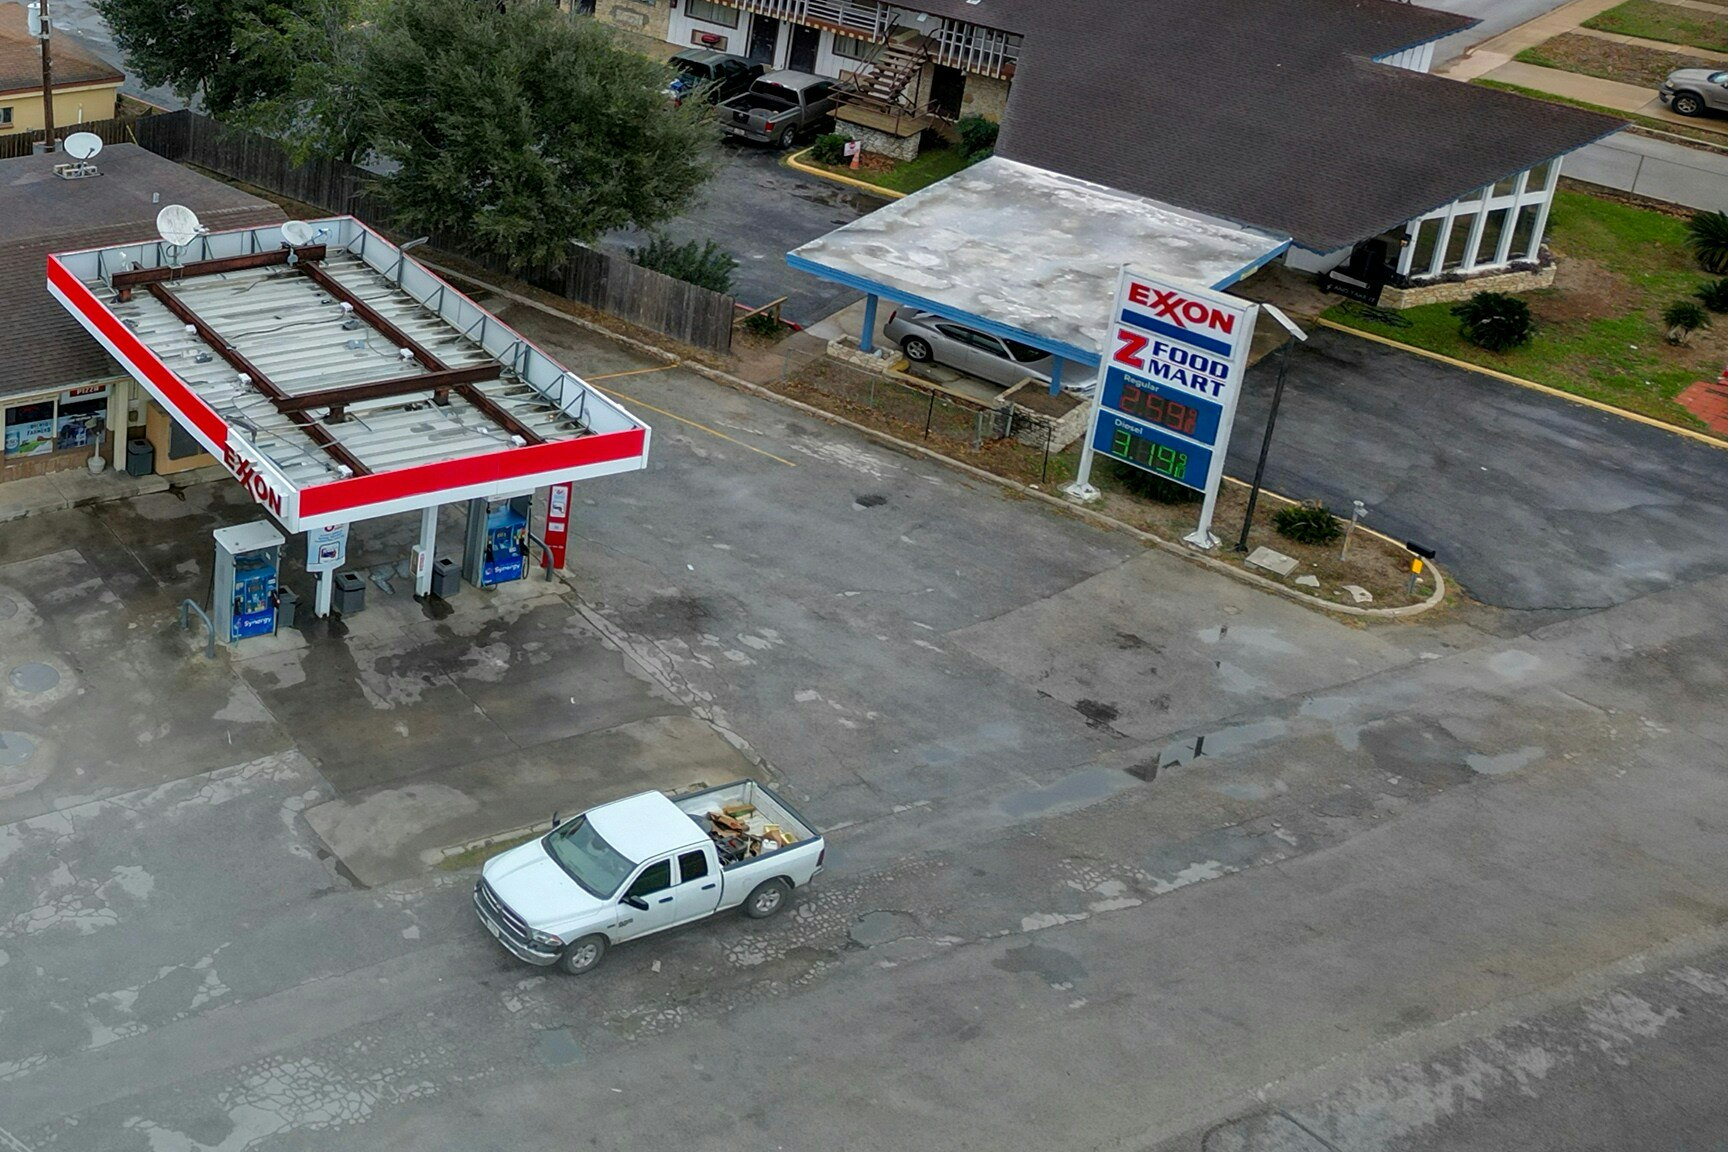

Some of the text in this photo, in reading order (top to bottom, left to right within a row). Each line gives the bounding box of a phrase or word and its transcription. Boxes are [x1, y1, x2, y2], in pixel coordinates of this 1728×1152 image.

[1128, 281, 1236, 335] EXXON
[1113, 328, 1229, 380] Z FOOD
[1123, 374, 1160, 393] Regular
[1148, 359, 1226, 398] MART
[1114, 418, 1144, 435] Diesel
[224, 441, 282, 517] EXXON
[494, 564, 521, 573] Synergy
[244, 617, 272, 627] Synergy
